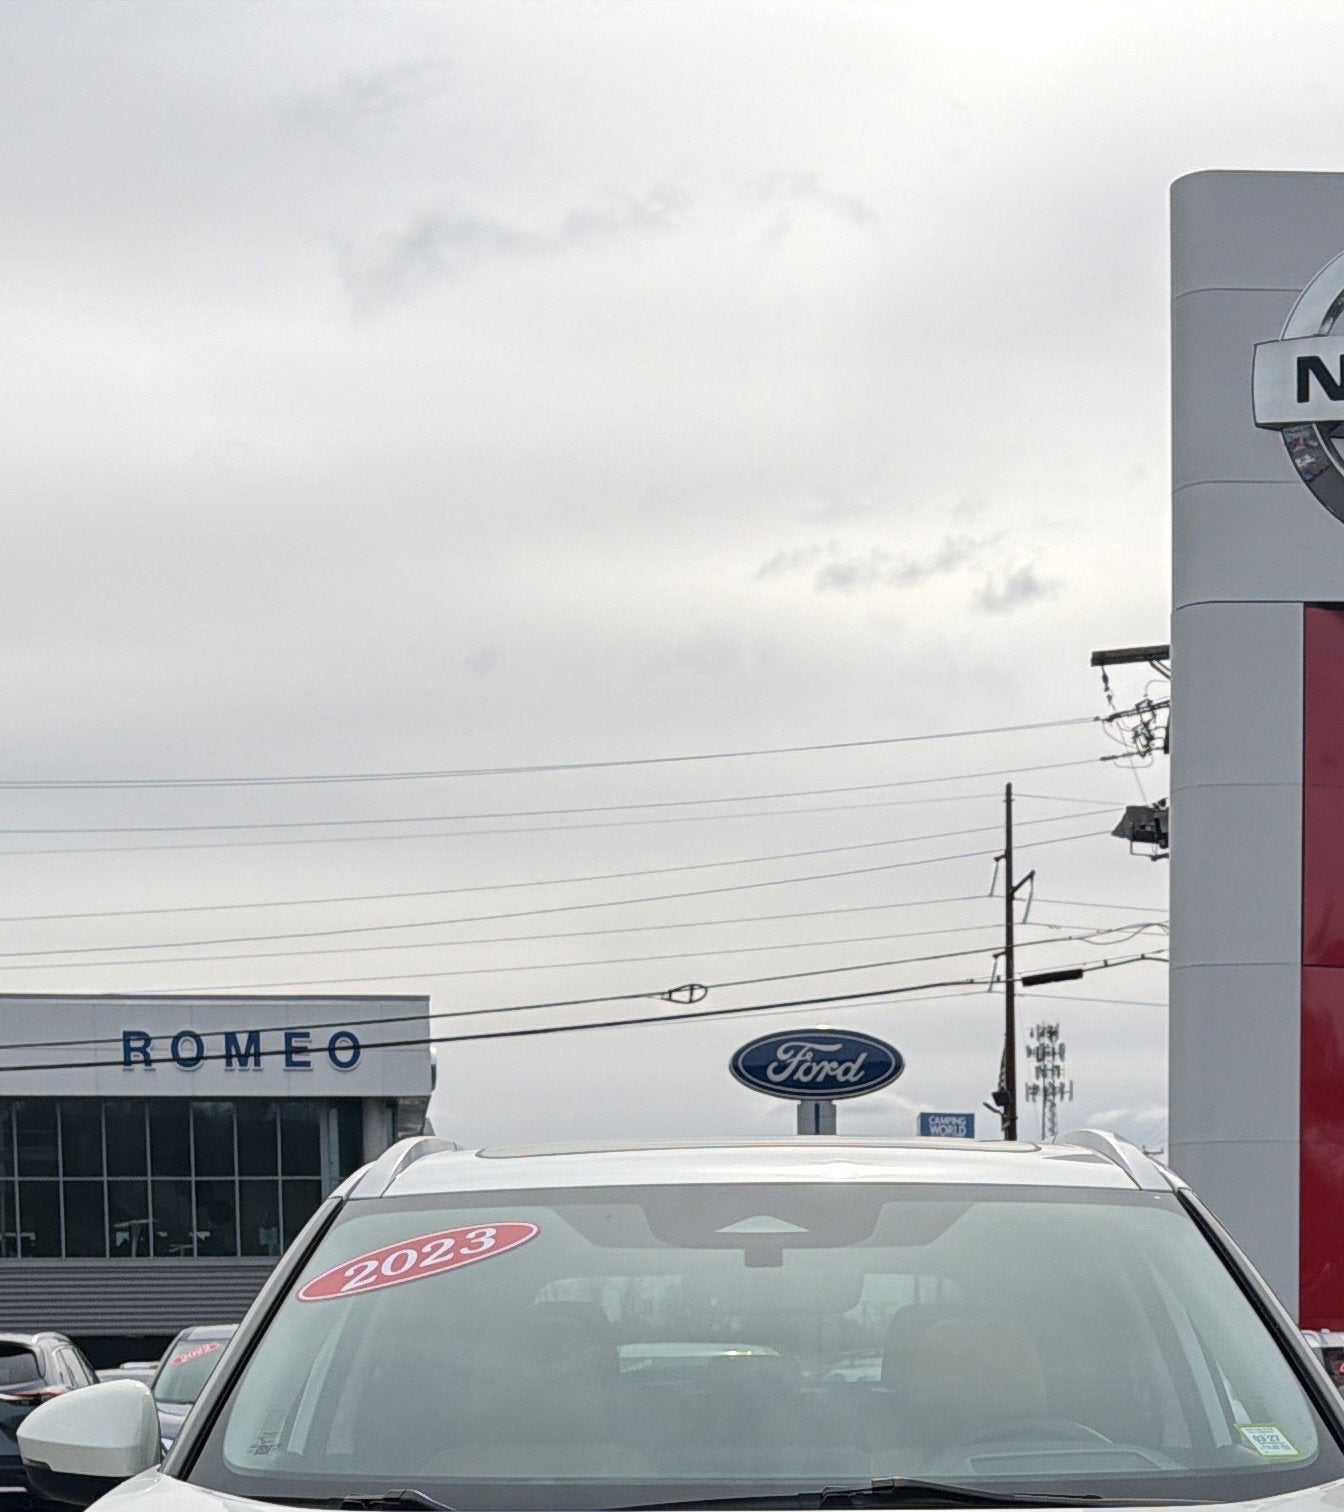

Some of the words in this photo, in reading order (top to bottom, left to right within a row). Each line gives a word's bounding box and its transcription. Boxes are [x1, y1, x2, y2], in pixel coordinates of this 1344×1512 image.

[122, 1030, 362, 1070] ROMEO
[766, 1041, 868, 1083] Ford
[928, 1115, 967, 1127] CAMPING
[929, 1126, 967, 1137] WORLD
[339, 1227, 498, 1293] 2023
